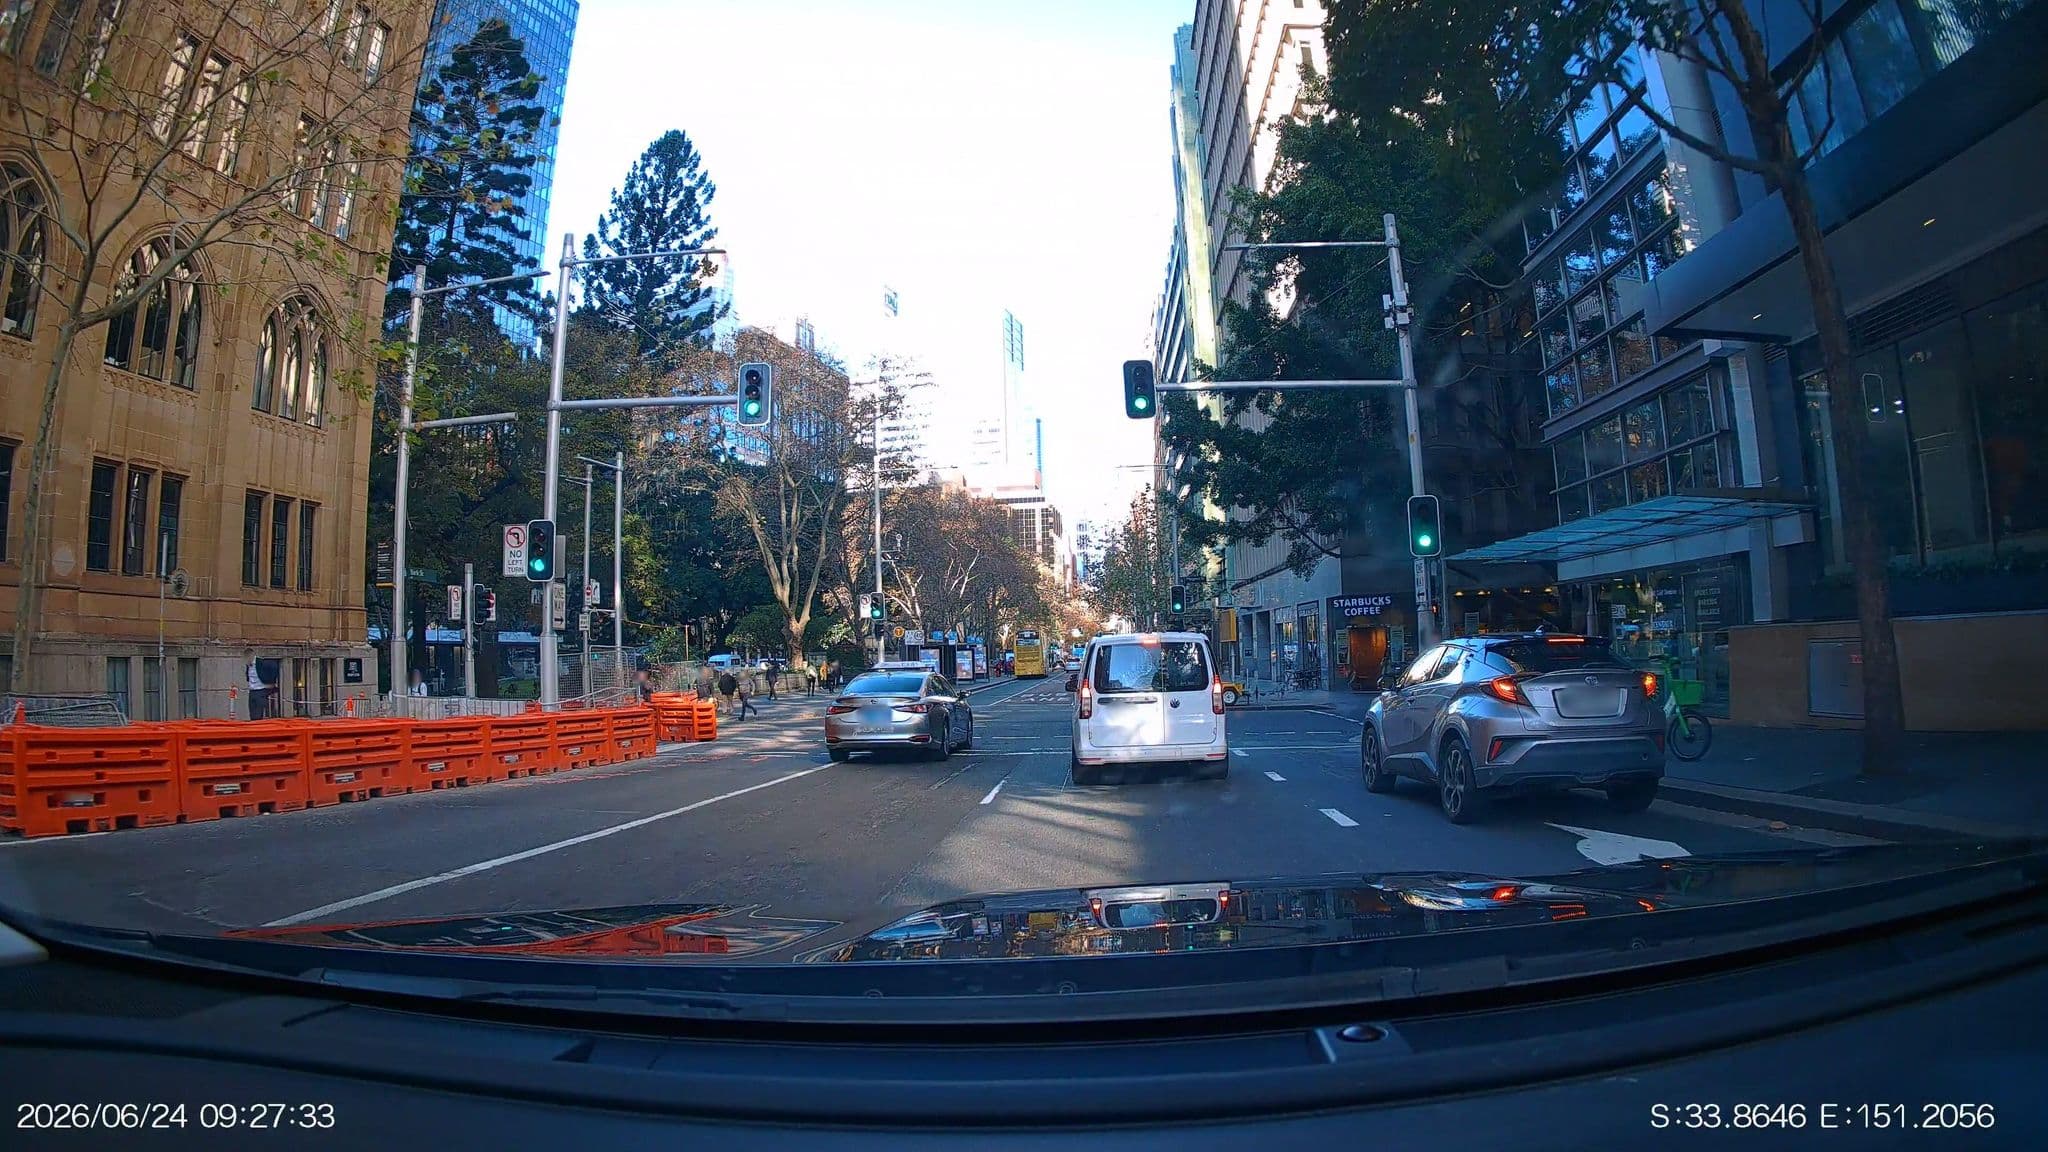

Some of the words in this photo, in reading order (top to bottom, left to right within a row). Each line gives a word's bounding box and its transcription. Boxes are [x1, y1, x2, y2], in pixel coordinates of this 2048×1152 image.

[509, 550, 522, 558] NO
[1333, 595, 1392, 608] STARBUCKS
[1344, 606, 1381, 617] COFFEE
